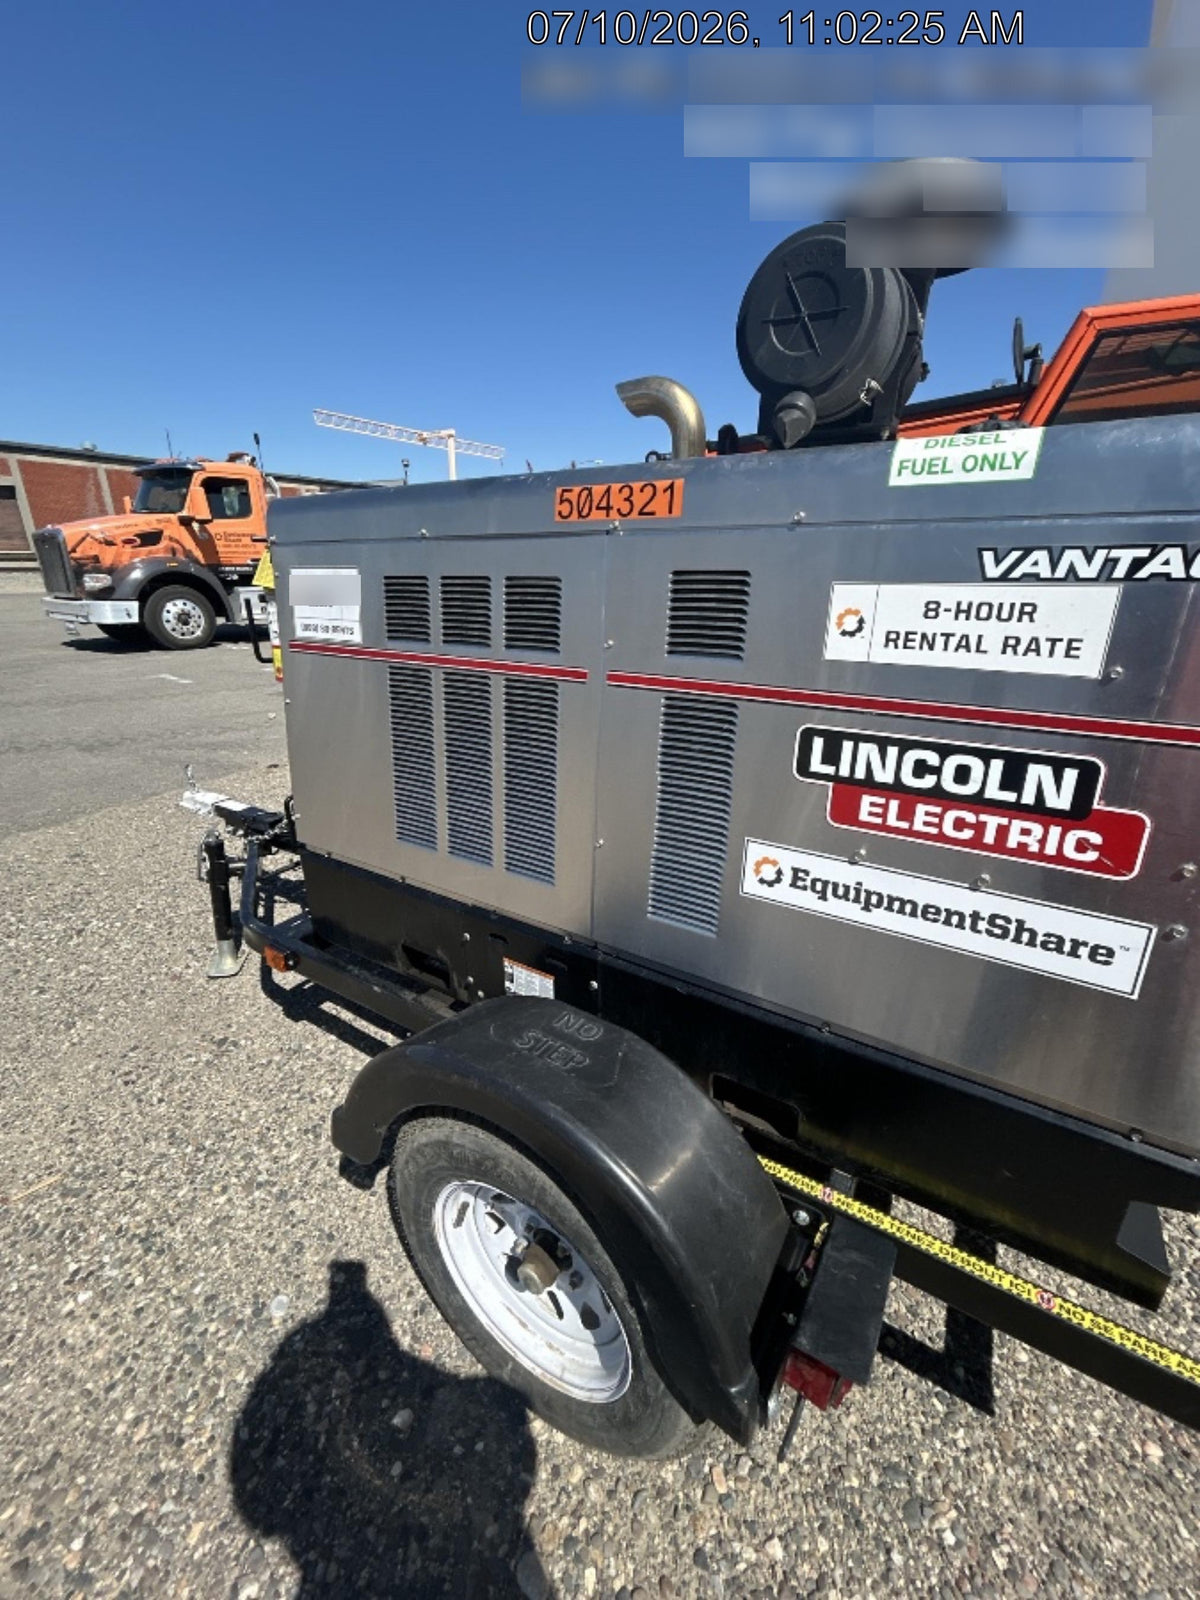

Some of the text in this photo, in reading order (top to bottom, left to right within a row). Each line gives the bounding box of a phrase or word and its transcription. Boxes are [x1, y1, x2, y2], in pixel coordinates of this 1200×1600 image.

[924, 433, 1007, 449] DIESEL
[897, 450, 1028, 476] FUEL ONLY
[558, 481, 675, 519] 504321
[922, 600, 1038, 624] 8-HOUR
[884, 630, 1084, 660] RENTAL RATE
[808, 735, 1080, 811] LINCOLN
[858, 794, 1104, 863] ELECTRIC
[553, 1010, 604, 1041] NO
[513, 1029, 590, 1069] STEP
[858, 1206, 885, 1226] PAS
[939, 1245, 1005, 1284] DEBOUT
[1009, 1278, 1032, 1298] ICI
[1059, 1303, 1086, 1322] NO
[1090, 1318, 1115, 1335] SE
[1119, 1332, 1171, 1361] PARE
